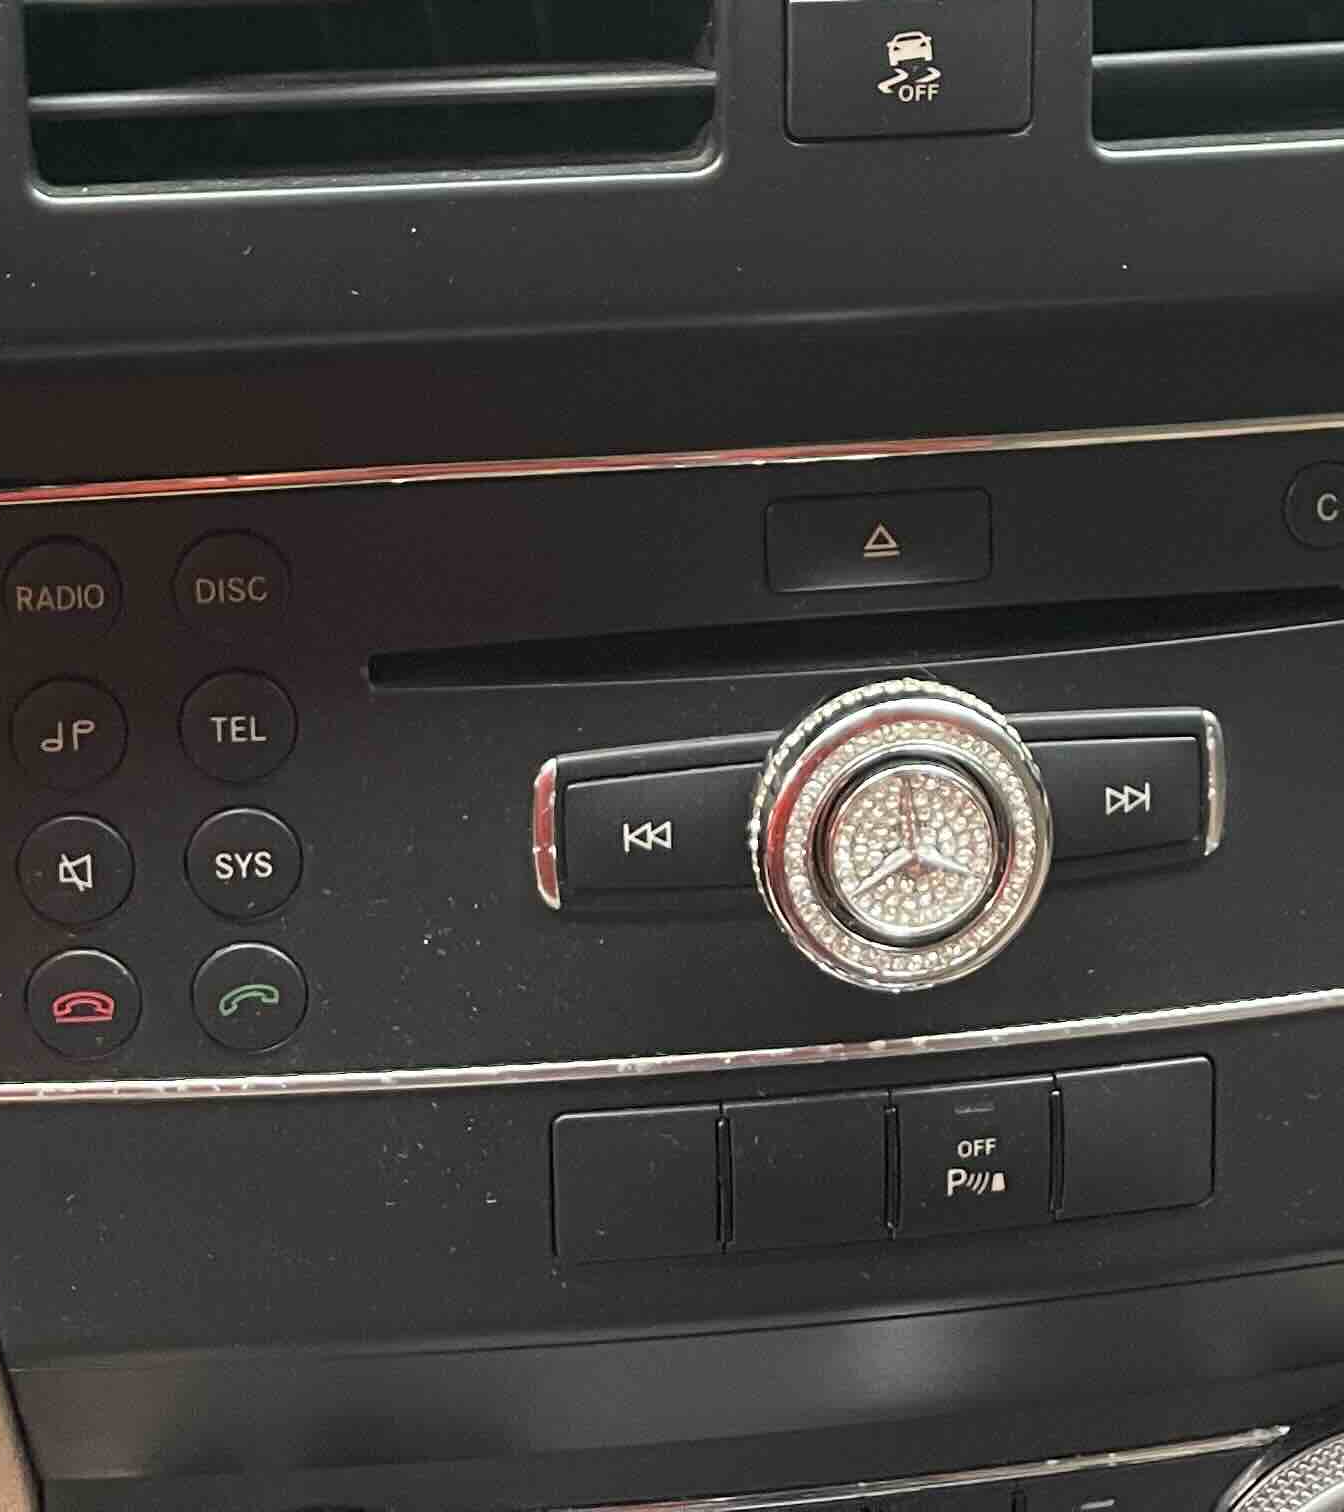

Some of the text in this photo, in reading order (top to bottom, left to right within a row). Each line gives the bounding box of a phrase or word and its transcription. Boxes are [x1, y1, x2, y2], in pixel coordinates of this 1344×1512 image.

[898, 83, 940, 102] OFF
[1316, 494, 1339, 521] C
[16, 584, 105, 611] RADIO
[195, 576, 269, 604] DISC
[211, 716, 267, 743] TEL
[215, 851, 273, 880] SYS
[957, 1138, 997, 1159] OFF
